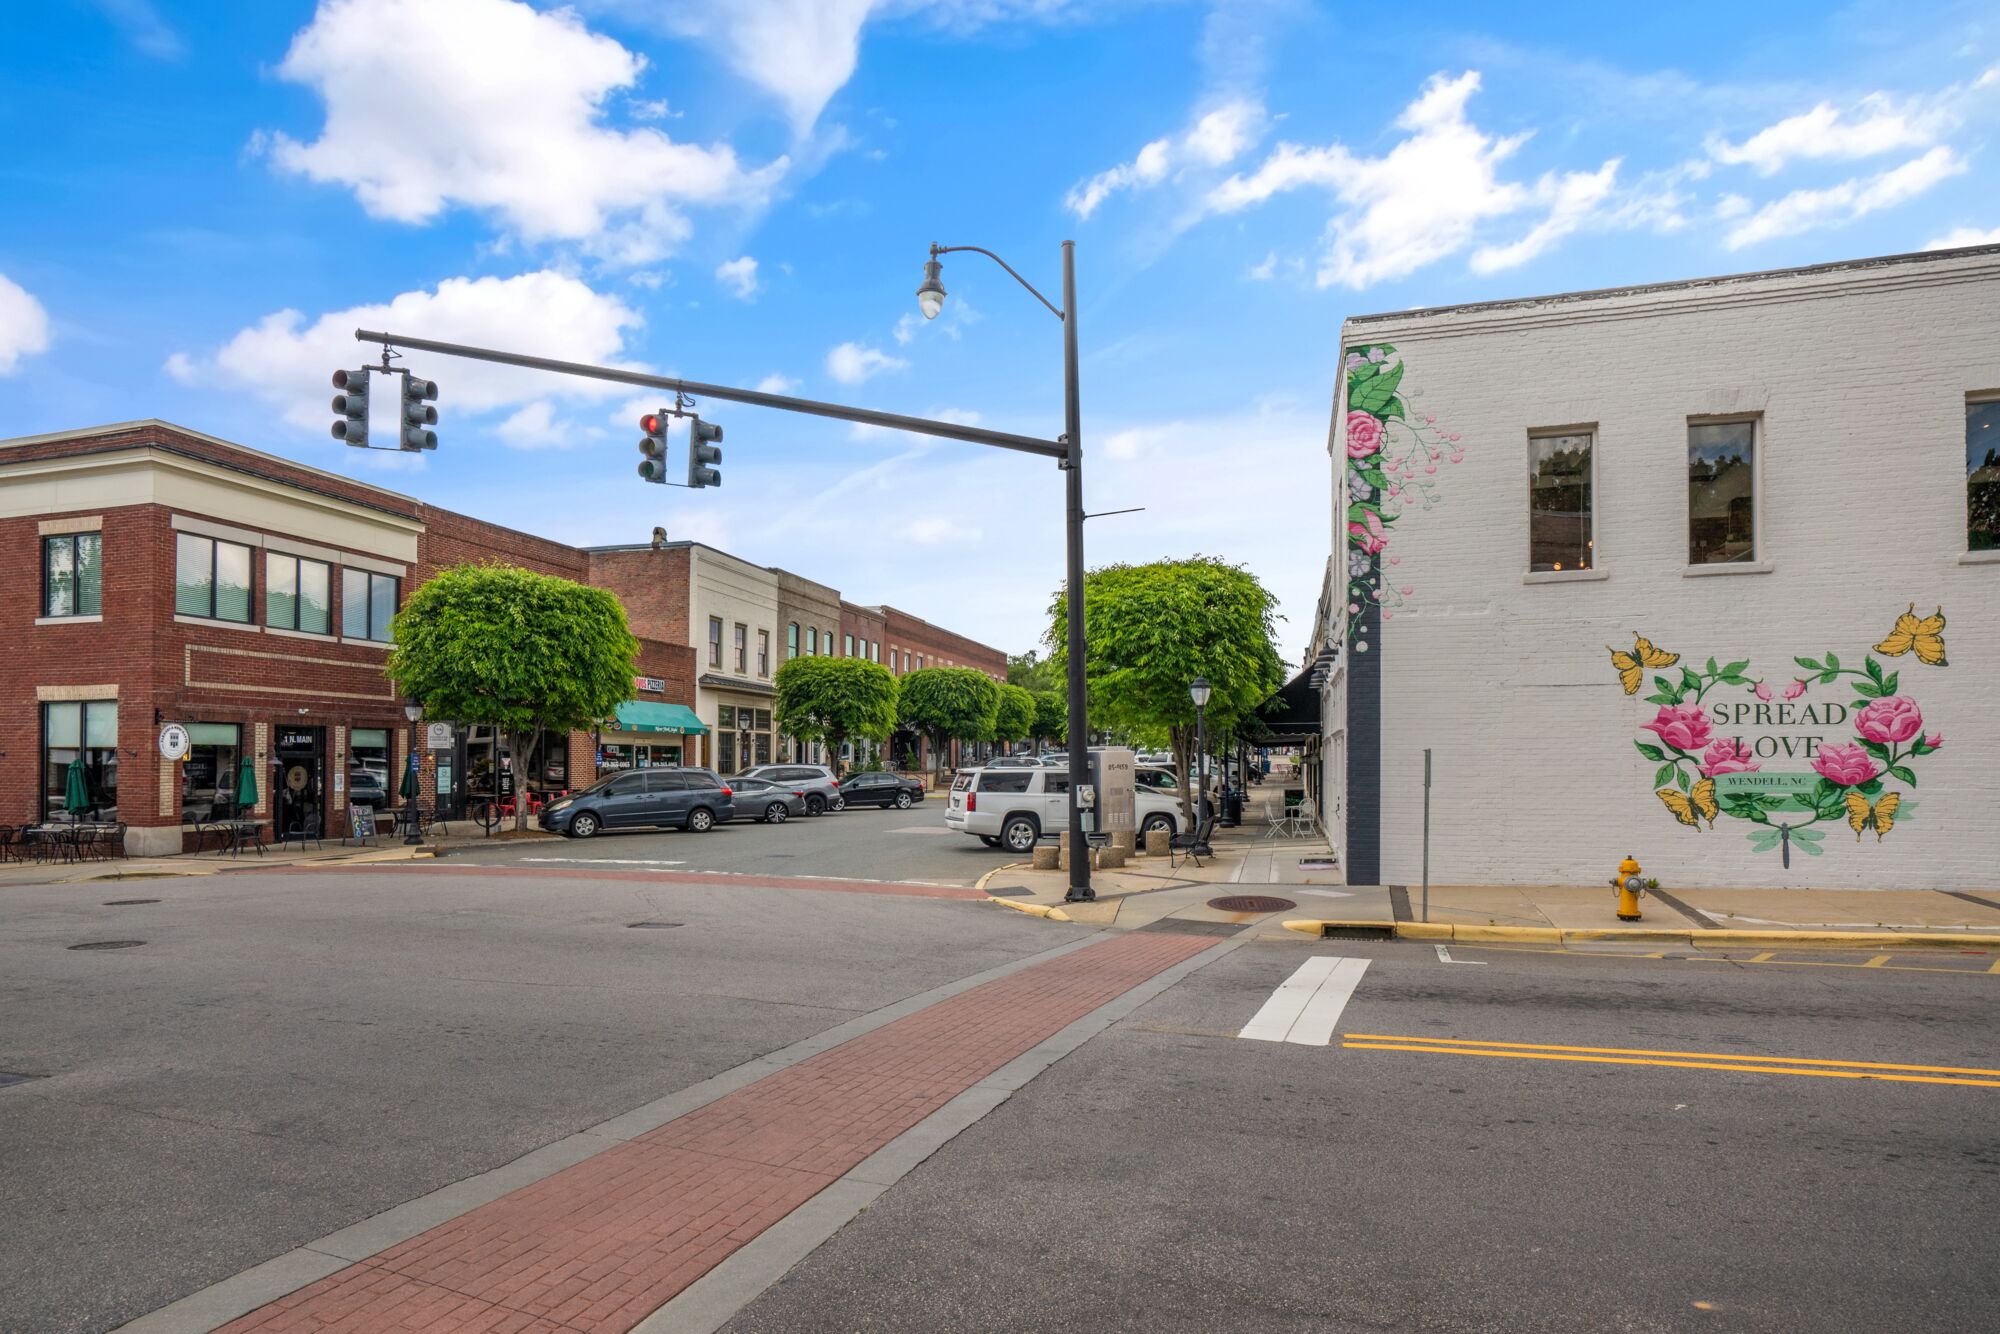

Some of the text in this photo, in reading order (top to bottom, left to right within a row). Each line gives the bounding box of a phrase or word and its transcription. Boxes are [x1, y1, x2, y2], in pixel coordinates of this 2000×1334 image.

[1713, 703, 1847, 725] SPREAD
[296, 735, 312, 743] MAIN
[1733, 736, 1824, 758] LOVE
[1728, 777, 1806, 787] WENDELL, NC
